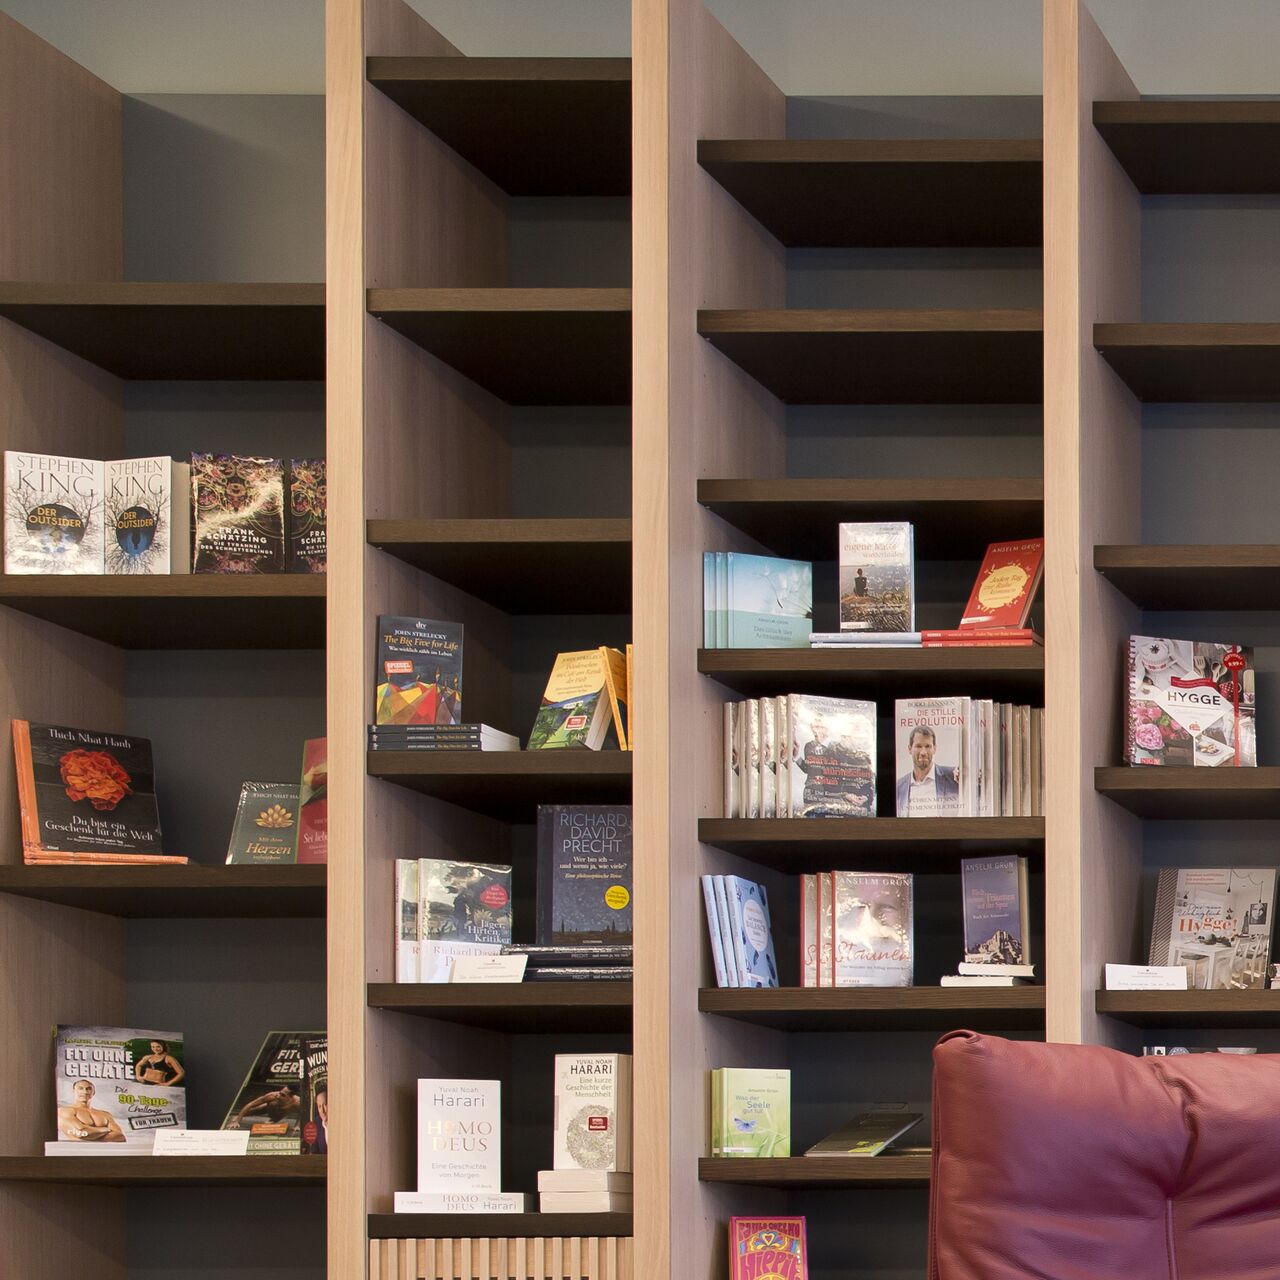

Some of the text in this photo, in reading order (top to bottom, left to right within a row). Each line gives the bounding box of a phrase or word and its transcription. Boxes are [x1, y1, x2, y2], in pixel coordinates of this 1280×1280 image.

[17, 455, 94, 475] STEPHEN
[110, 459, 163, 475] STEPHEN
[16, 470, 95, 498] KING
[110, 476, 163, 498] KING
[37, 507, 57, 518] DER
[123, 511, 137, 521] DER
[28, 515, 82, 529] OUTSIDER
[118, 518, 154, 530] OUTSIDER
[220, 527, 255, 537] FRANK
[206, 533, 267, 544] SCHÄTZING
[992, 545, 1019, 553] ANSELM
[394, 629, 447, 640] JOHN STRELECKY
[384, 635, 458, 651] The Big Five for Life
[1167, 691, 1221, 706] HYGGE
[931, 708, 957, 716] STILLE
[900, 715, 965, 727] REVOLUTION
[49, 728, 131, 750] Thich Nhat Hanh
[73, 815, 126, 831] Du bist ein
[559, 813, 628, 827] RICHARD
[45, 820, 94, 835] Geschenk
[113, 828, 128, 839] die
[130, 829, 154, 842] Welt
[570, 827, 617, 840] DAVID
[245, 842, 292, 855] Herzen
[562, 840, 623, 853] PRECHT
[840, 876, 909, 887] ANSELM GRÜN
[480, 919, 506, 929] Jäger,
[1179, 915, 1238, 934] Hygge!
[468, 926, 501, 936] Hirten,
[474, 934, 511, 944] Kritiker
[433, 946, 471, 956] Richard
[65, 1048, 133, 1063] FIT OHNE
[277, 1050, 296, 1060] FIT
[65, 1062, 135, 1080] GERÄTE
[570, 1064, 613, 1075] HARARI
[565, 1084, 600, 1092] Geschichte
[433, 1094, 485, 1108] Harari
[746, 1101, 771, 1109] Seele
[67, 1128, 89, 1137] riva
[426, 1120, 493, 1136] HOMO
[431, 1137, 488, 1152] DEUS
[442, 1195, 479, 1203] HOMO
[483, 1201, 517, 1211] Harari
